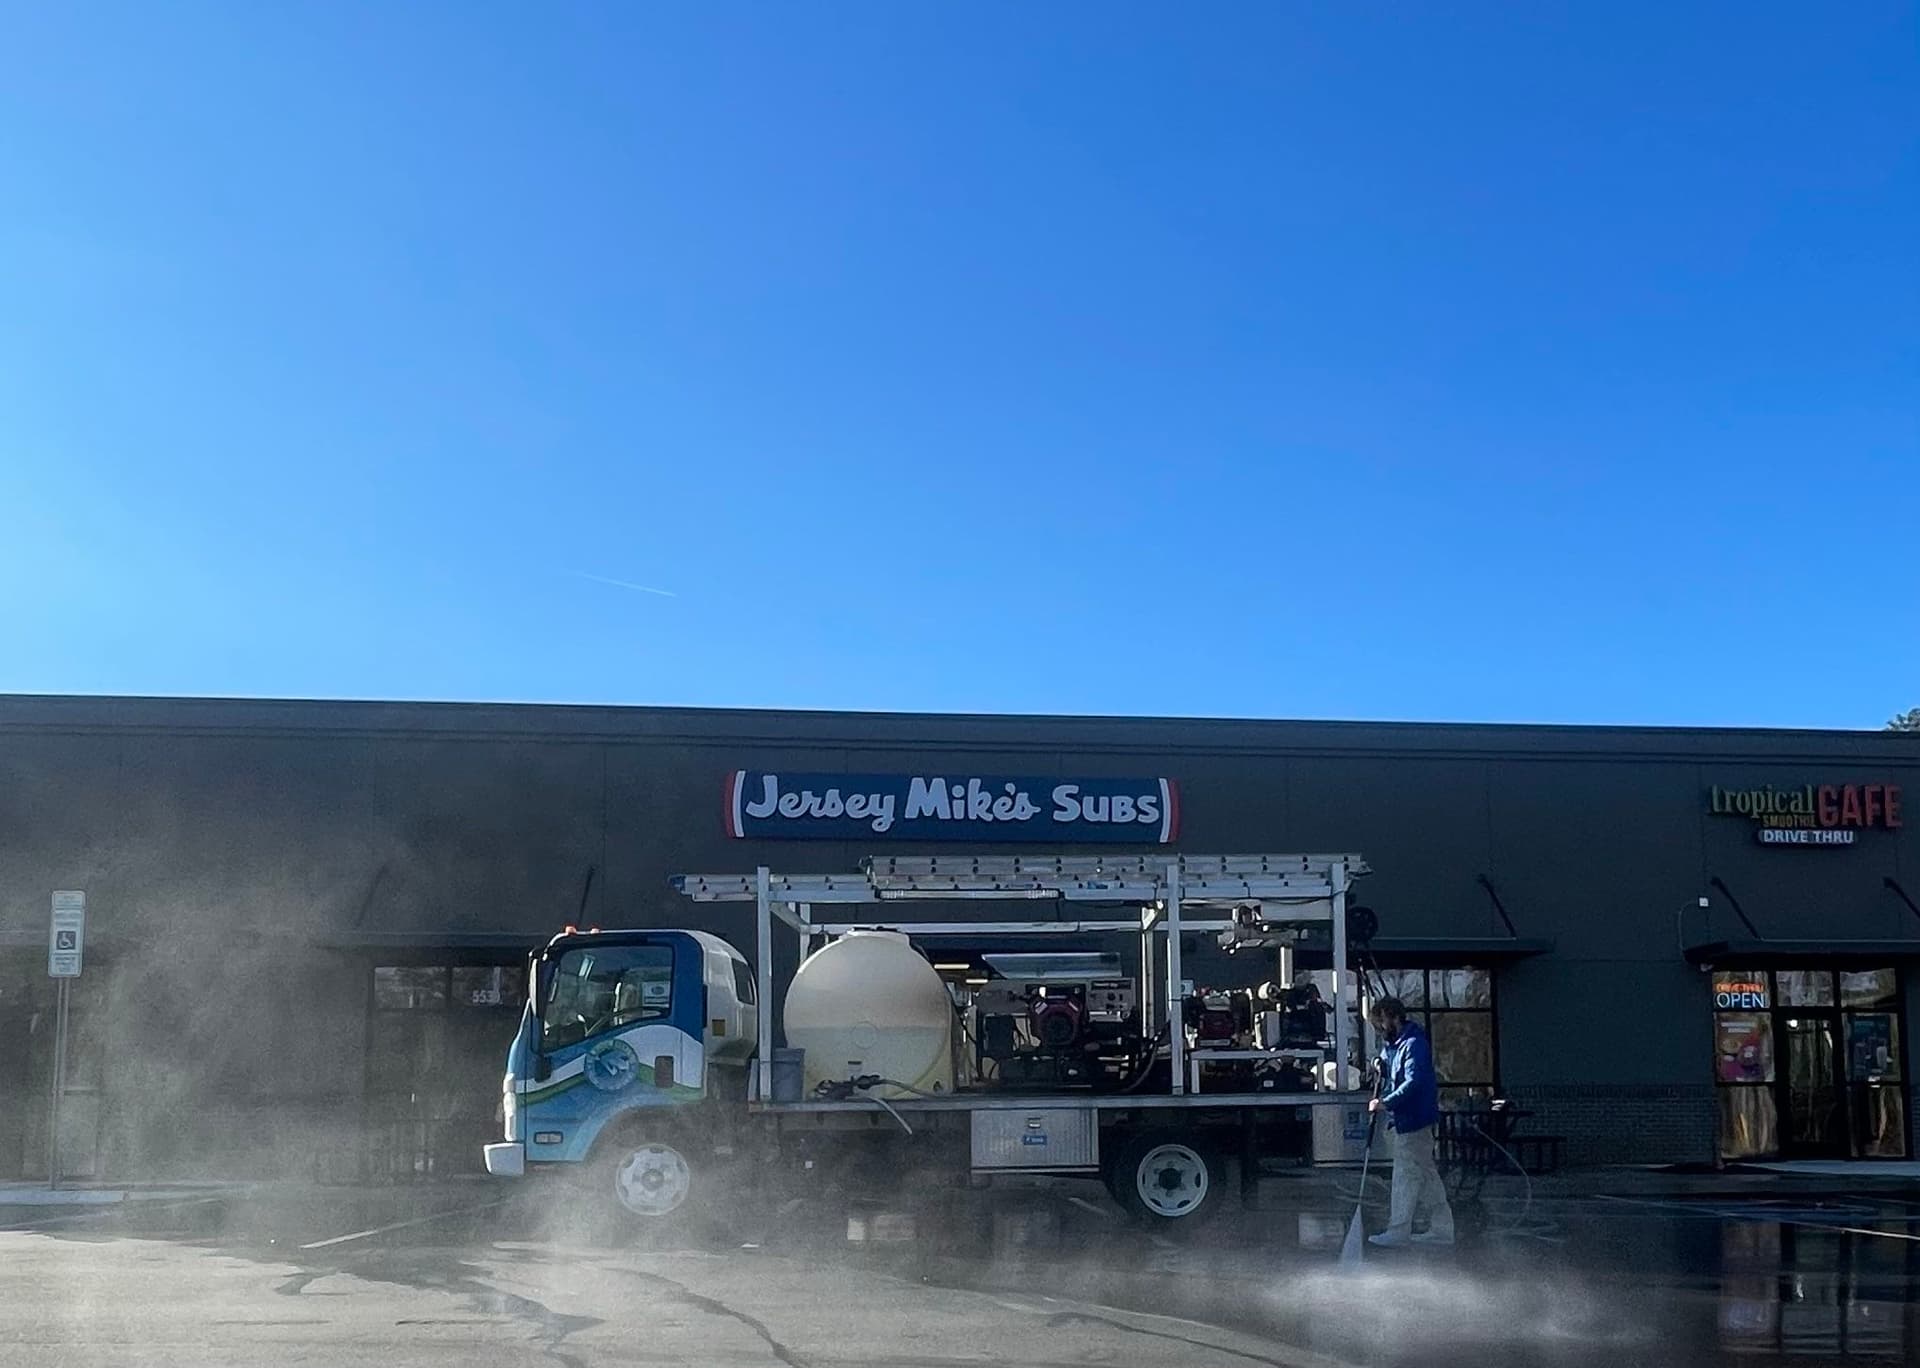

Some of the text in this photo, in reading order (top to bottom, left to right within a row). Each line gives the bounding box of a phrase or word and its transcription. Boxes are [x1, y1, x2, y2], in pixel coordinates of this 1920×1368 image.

[745, 774, 1160, 833] Jersey Mike's SUBS
[1711, 782, 1904, 828] tropical CAFE
[1763, 829, 1854, 844] DRIVE THRU
[1716, 992, 1765, 1009] OPEN
